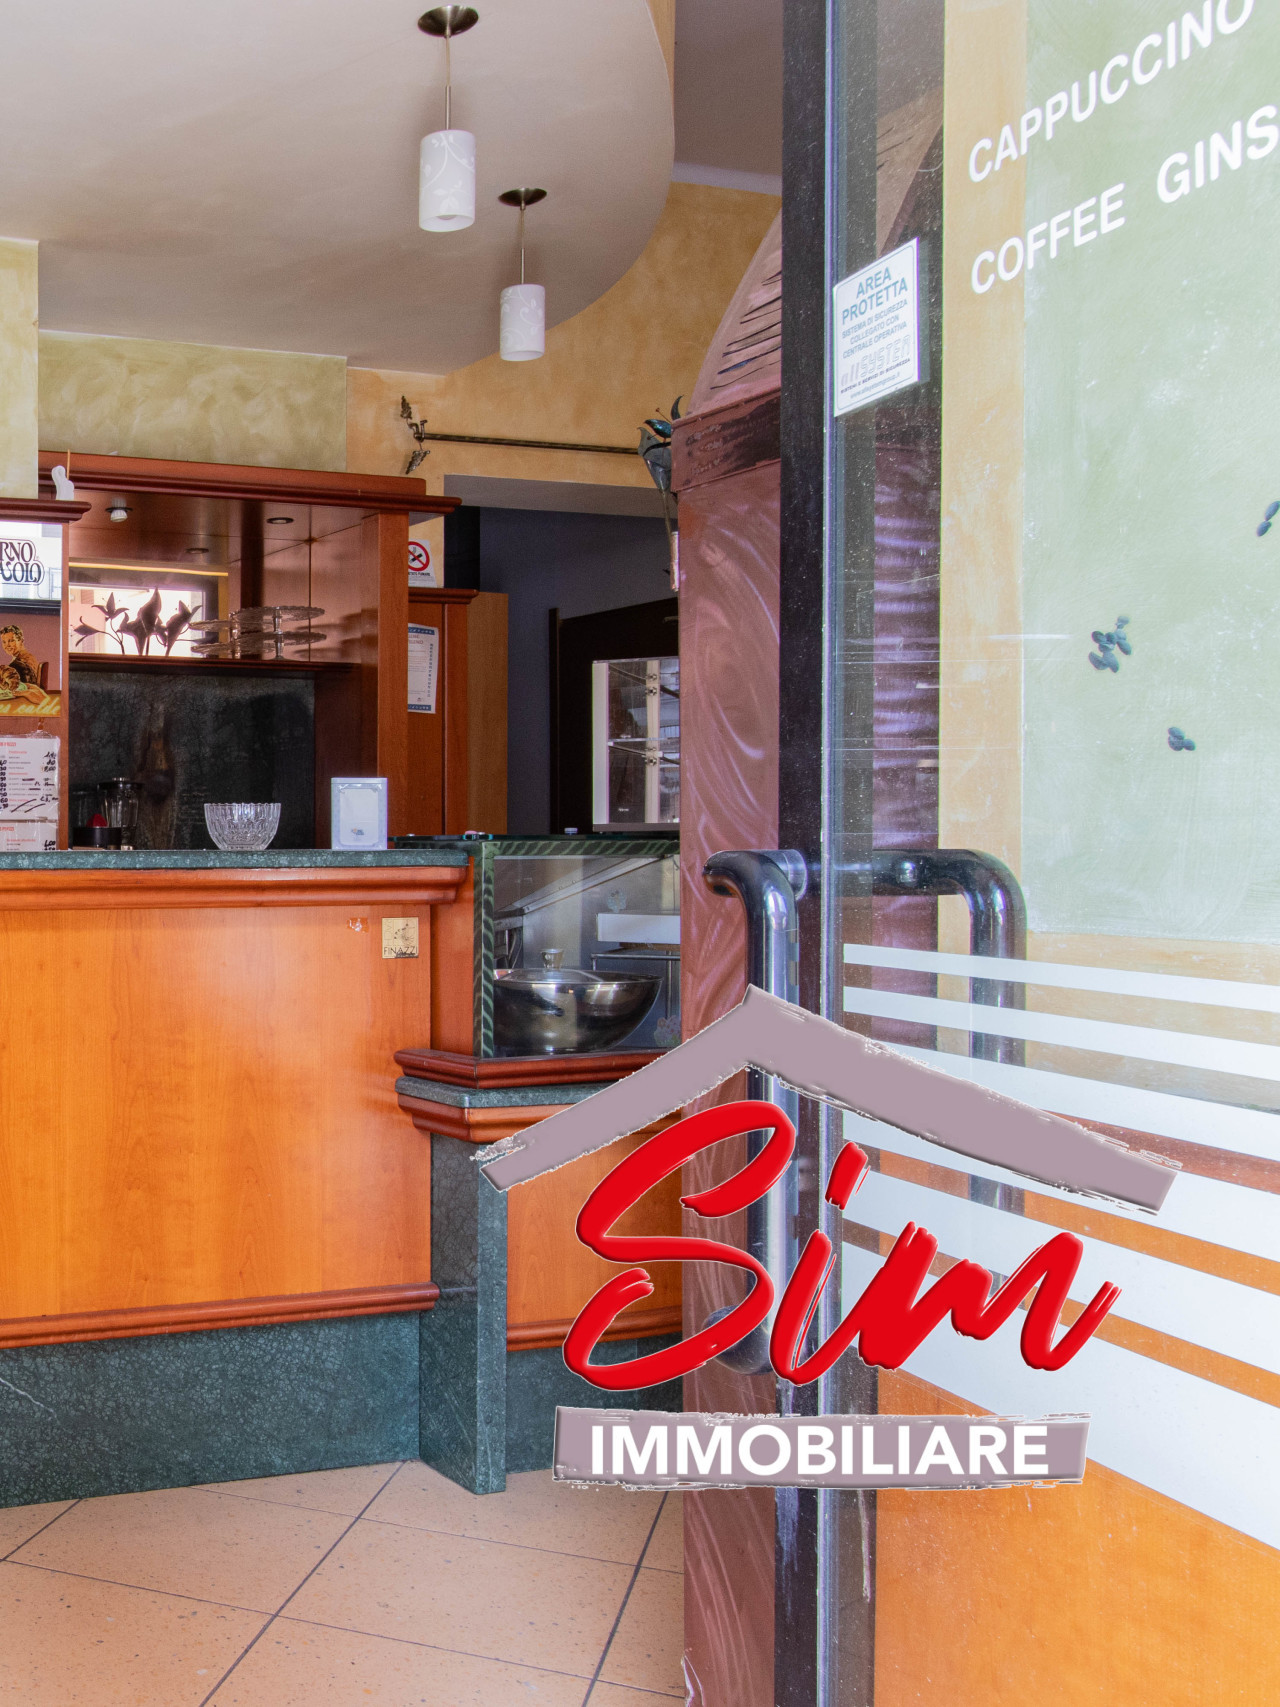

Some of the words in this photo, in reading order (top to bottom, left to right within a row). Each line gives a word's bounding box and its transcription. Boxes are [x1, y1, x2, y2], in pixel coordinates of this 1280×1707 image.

[968, 0, 1255, 183] CAPPUCCINO
[970, 182, 1126, 294] COFFEE
[1156, 105, 1280, 203] GINS
[842, 277, 908, 325] PROTETTA
[856, 266, 892, 299] AREA
[842, 320, 867, 339] SISTEMA
[867, 316, 874, 327] DI
[874, 299, 908, 322] SICUREZZA
[850, 322, 885, 345] COLLEGATO
[886, 315, 900, 329] CON
[842, 340, 873, 359] CENTRALE
[873, 321, 908, 344] OPERATIVA
